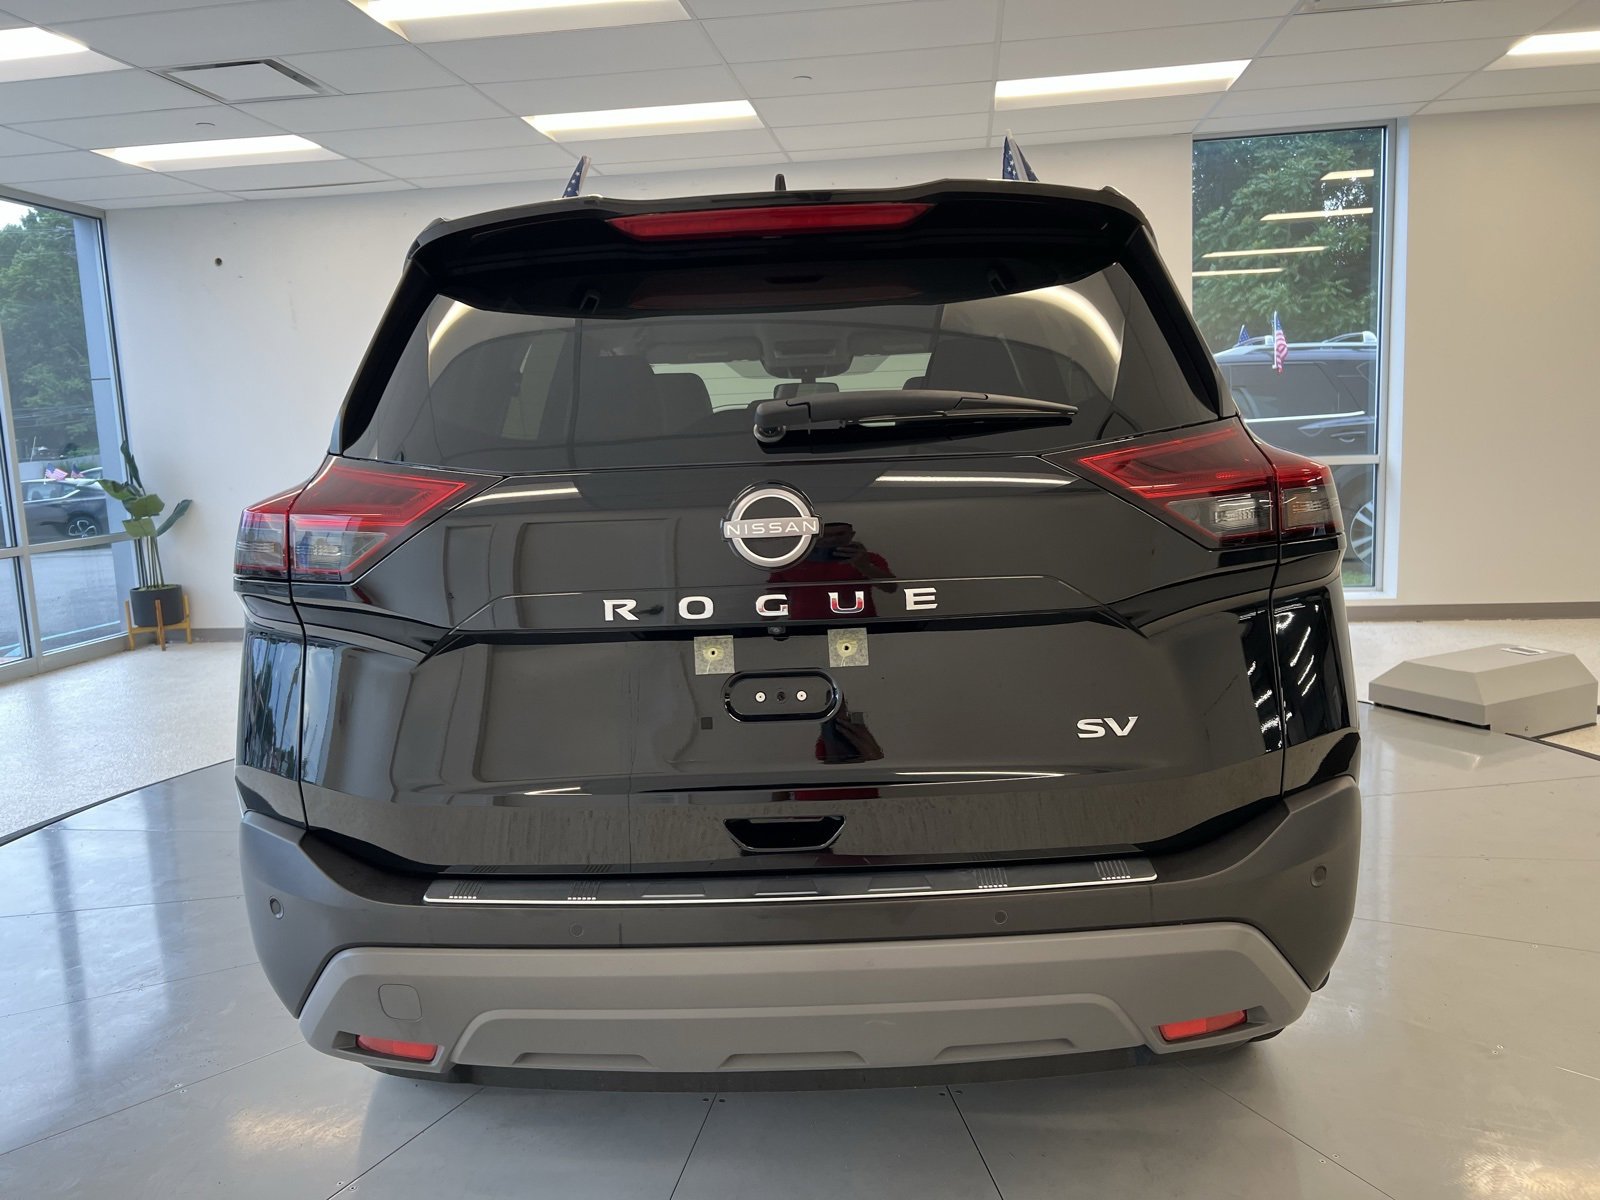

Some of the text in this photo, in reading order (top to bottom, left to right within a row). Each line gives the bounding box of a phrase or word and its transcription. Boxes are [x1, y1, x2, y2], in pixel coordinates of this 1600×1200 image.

[726, 520, 817, 536] NISSAN
[602, 587, 939, 622] ROGUE
[1076, 715, 1139, 739] SV
